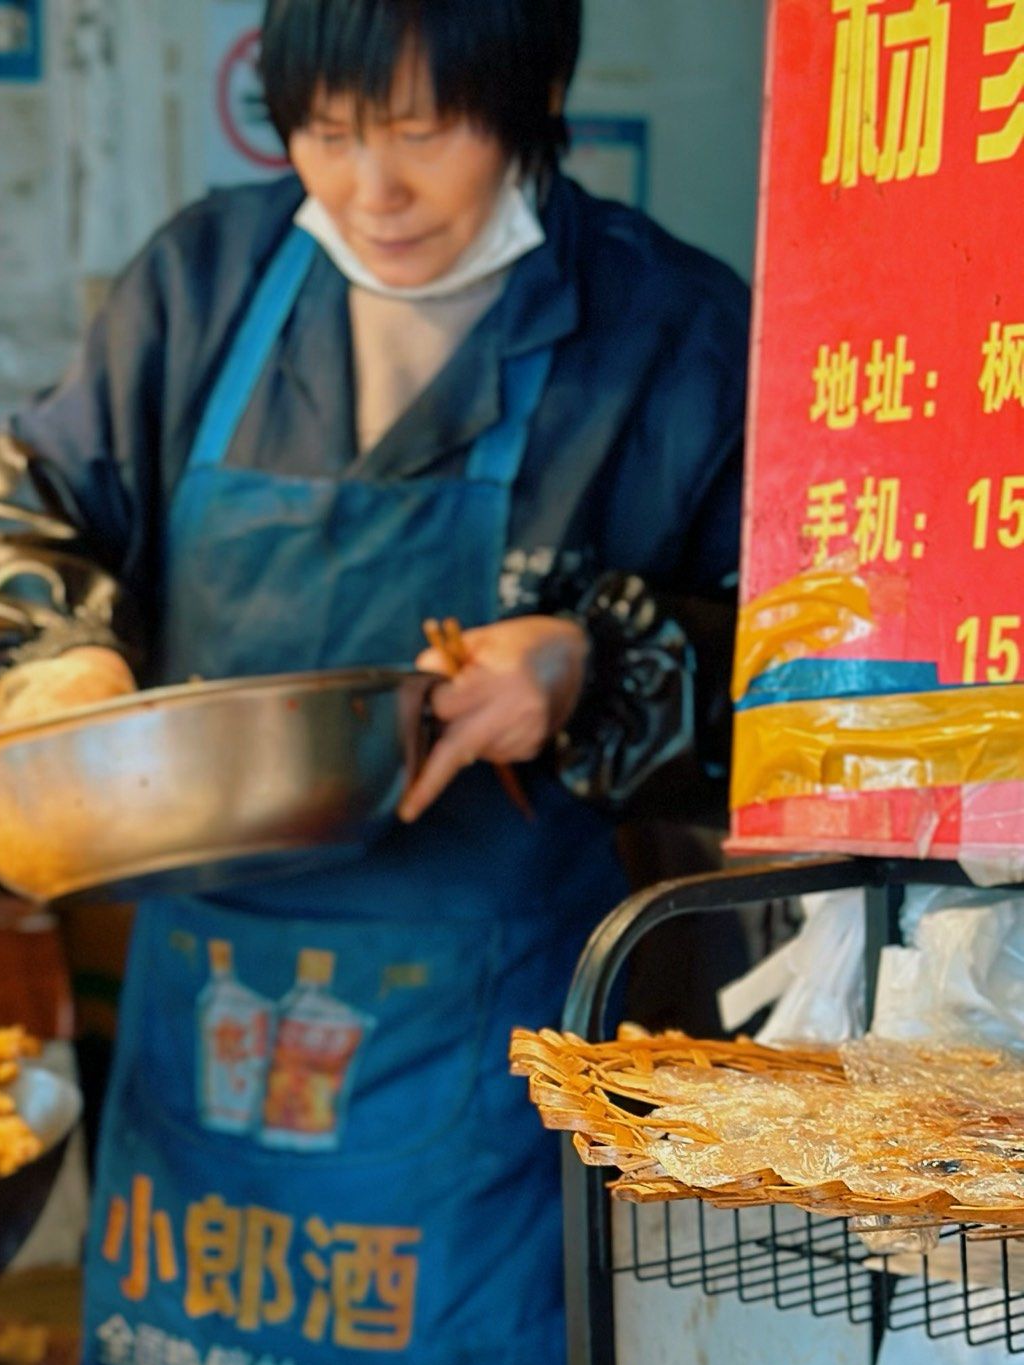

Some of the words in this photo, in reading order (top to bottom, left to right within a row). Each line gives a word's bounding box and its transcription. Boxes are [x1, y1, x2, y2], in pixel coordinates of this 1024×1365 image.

[809, 335, 938, 430] 地址：
[802, 476, 926, 567] 手机：
[967, 475, 1024, 549] 15
[956, 615, 1021, 685] 15
[101, 1173, 422, 1351] 小郎酒
